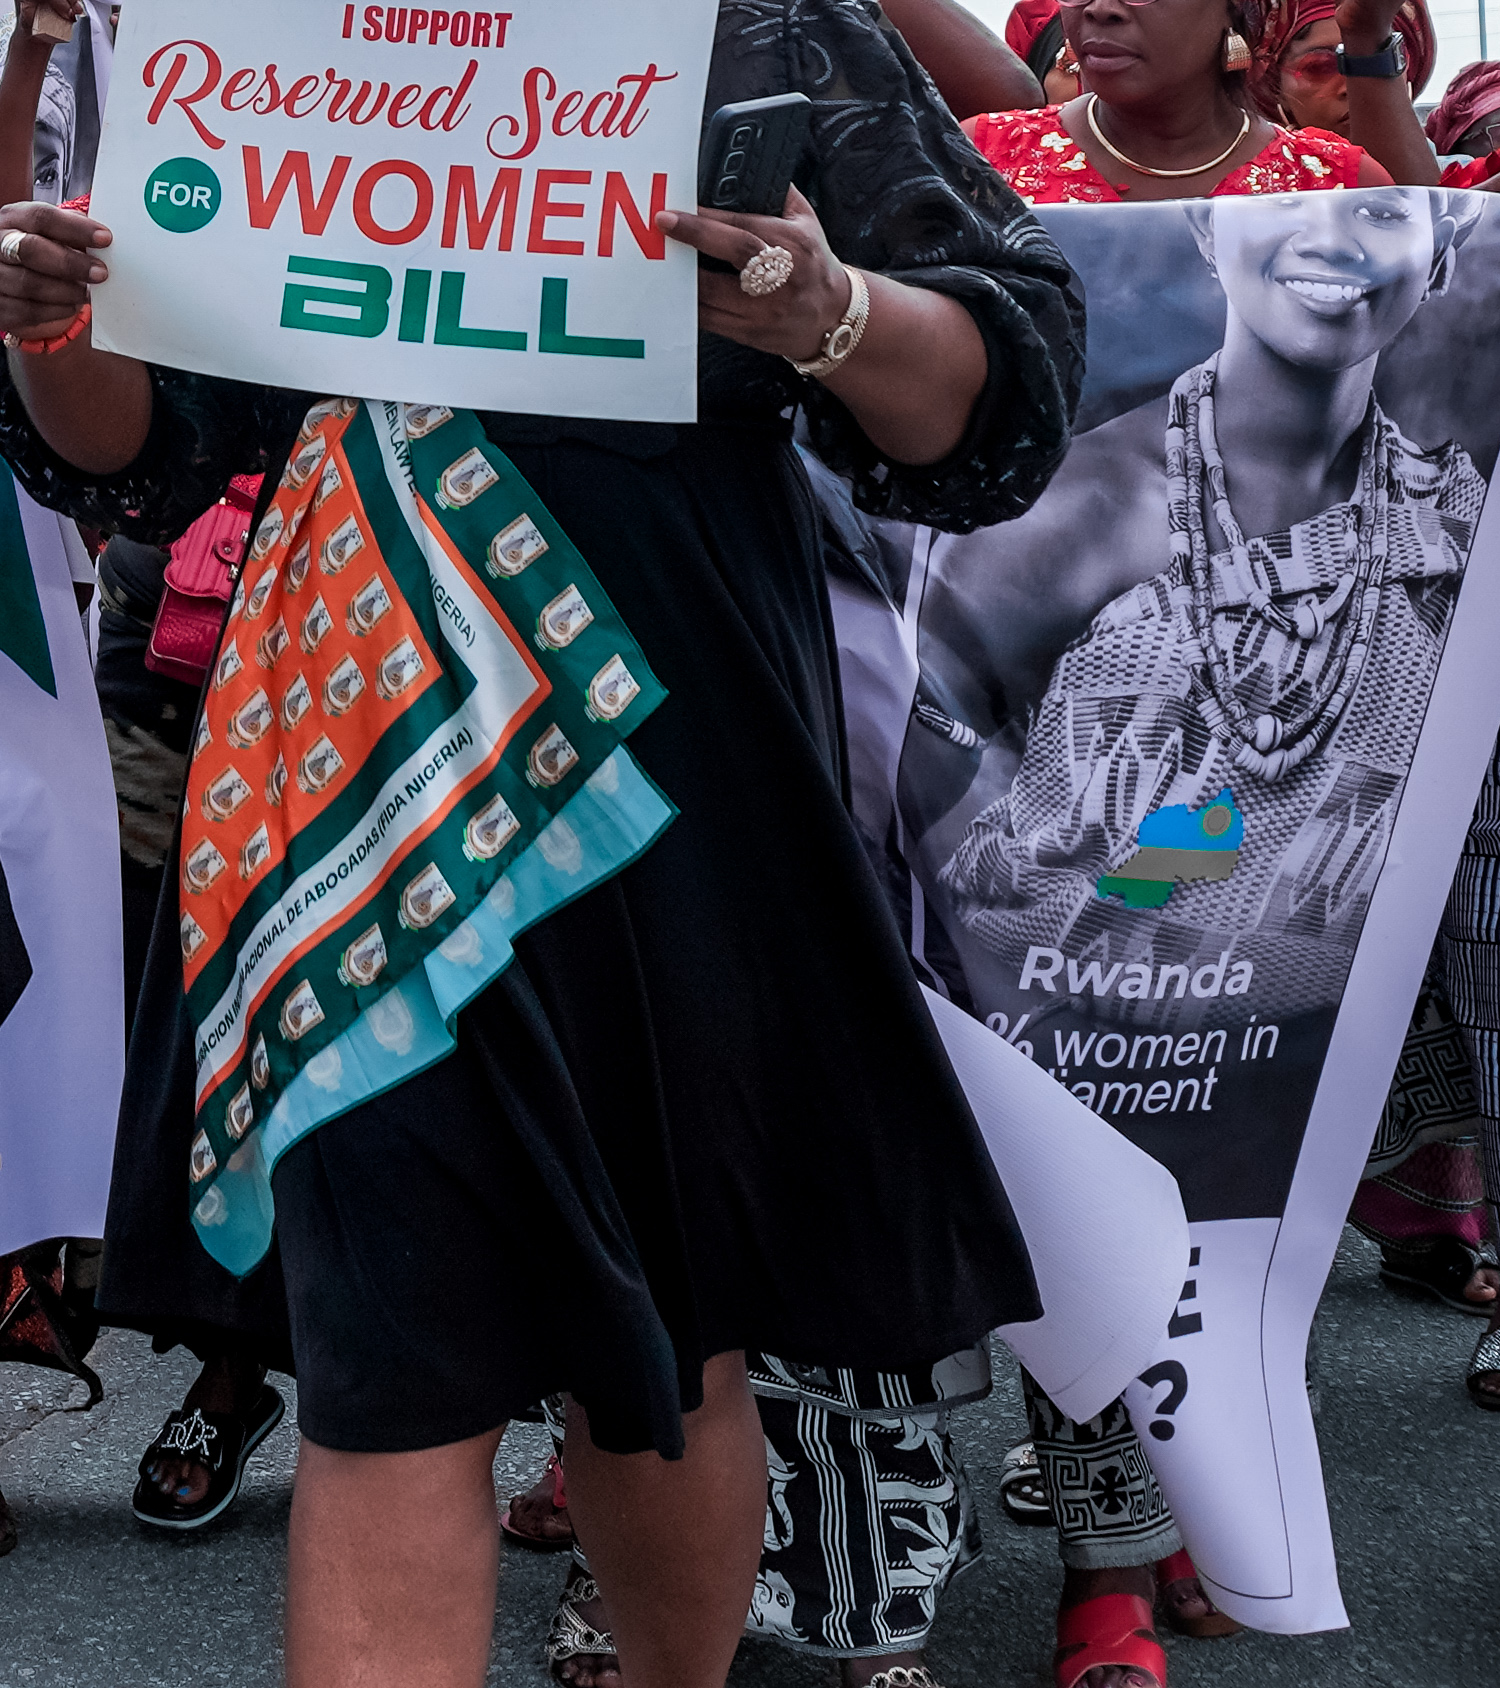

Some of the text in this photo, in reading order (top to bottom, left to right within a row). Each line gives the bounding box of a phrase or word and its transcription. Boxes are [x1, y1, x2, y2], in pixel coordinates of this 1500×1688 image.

[342, 4, 513, 50] I SUPPORT
[142, 39, 679, 161] Reserved Seat
[151, 144, 668, 261] FOR WOMEN
[279, 254, 645, 360] BILL
[286, 725, 474, 925] DE ABOGADAS (FIDA NIGERIA)
[1018, 946, 1255, 1001] Rwanda
[1053, 1028, 1226, 1070] women
[1240, 1015, 1279, 1061] in
